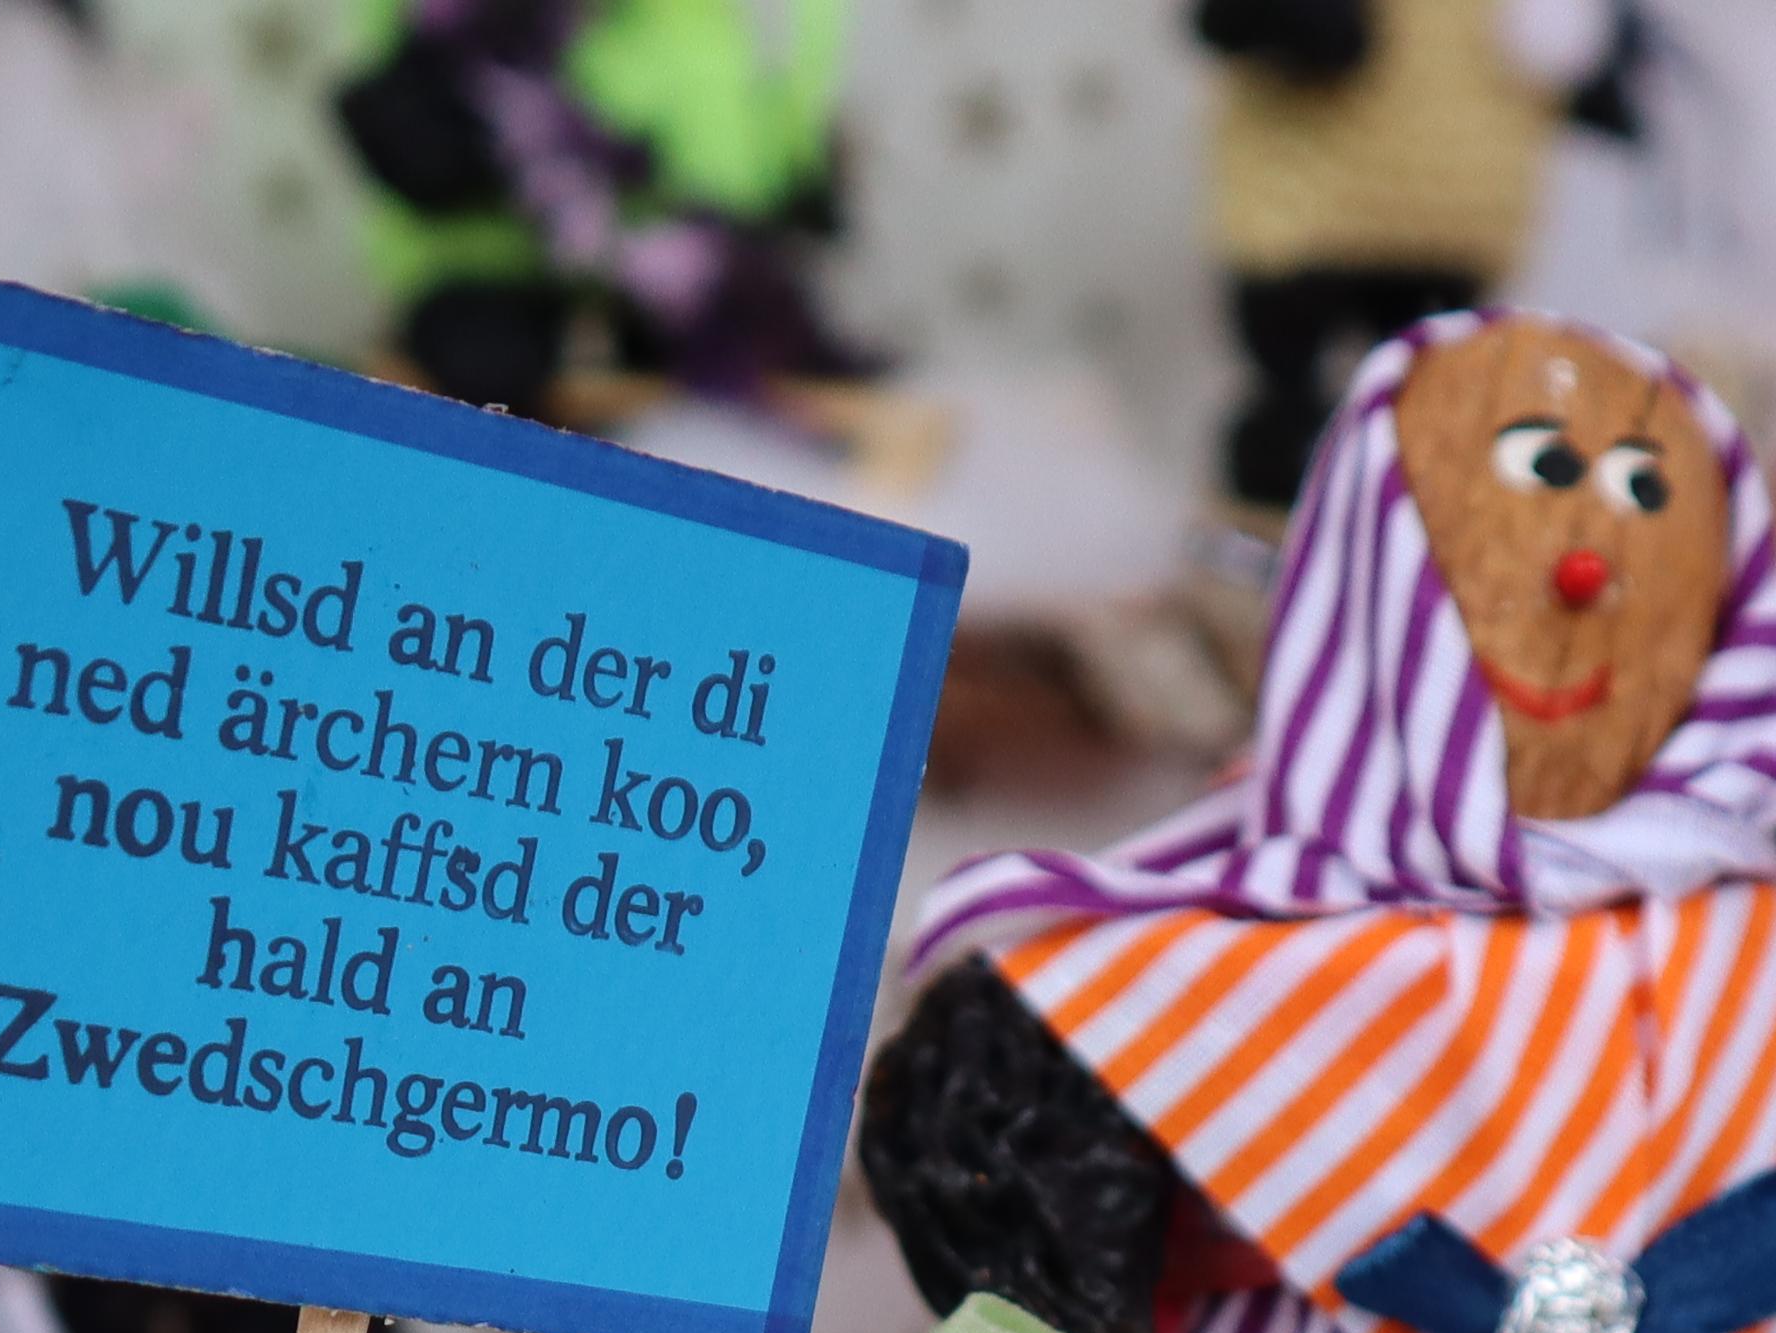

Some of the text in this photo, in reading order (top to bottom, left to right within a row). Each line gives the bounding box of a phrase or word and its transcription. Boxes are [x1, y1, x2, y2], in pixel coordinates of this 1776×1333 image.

[62, 499, 775, 746] Willsd an der di
[6, 640, 767, 877] ned ärchern koo,
[46, 775, 703, 956] nou kaffsd der
[196, 896, 526, 1040] hald an
